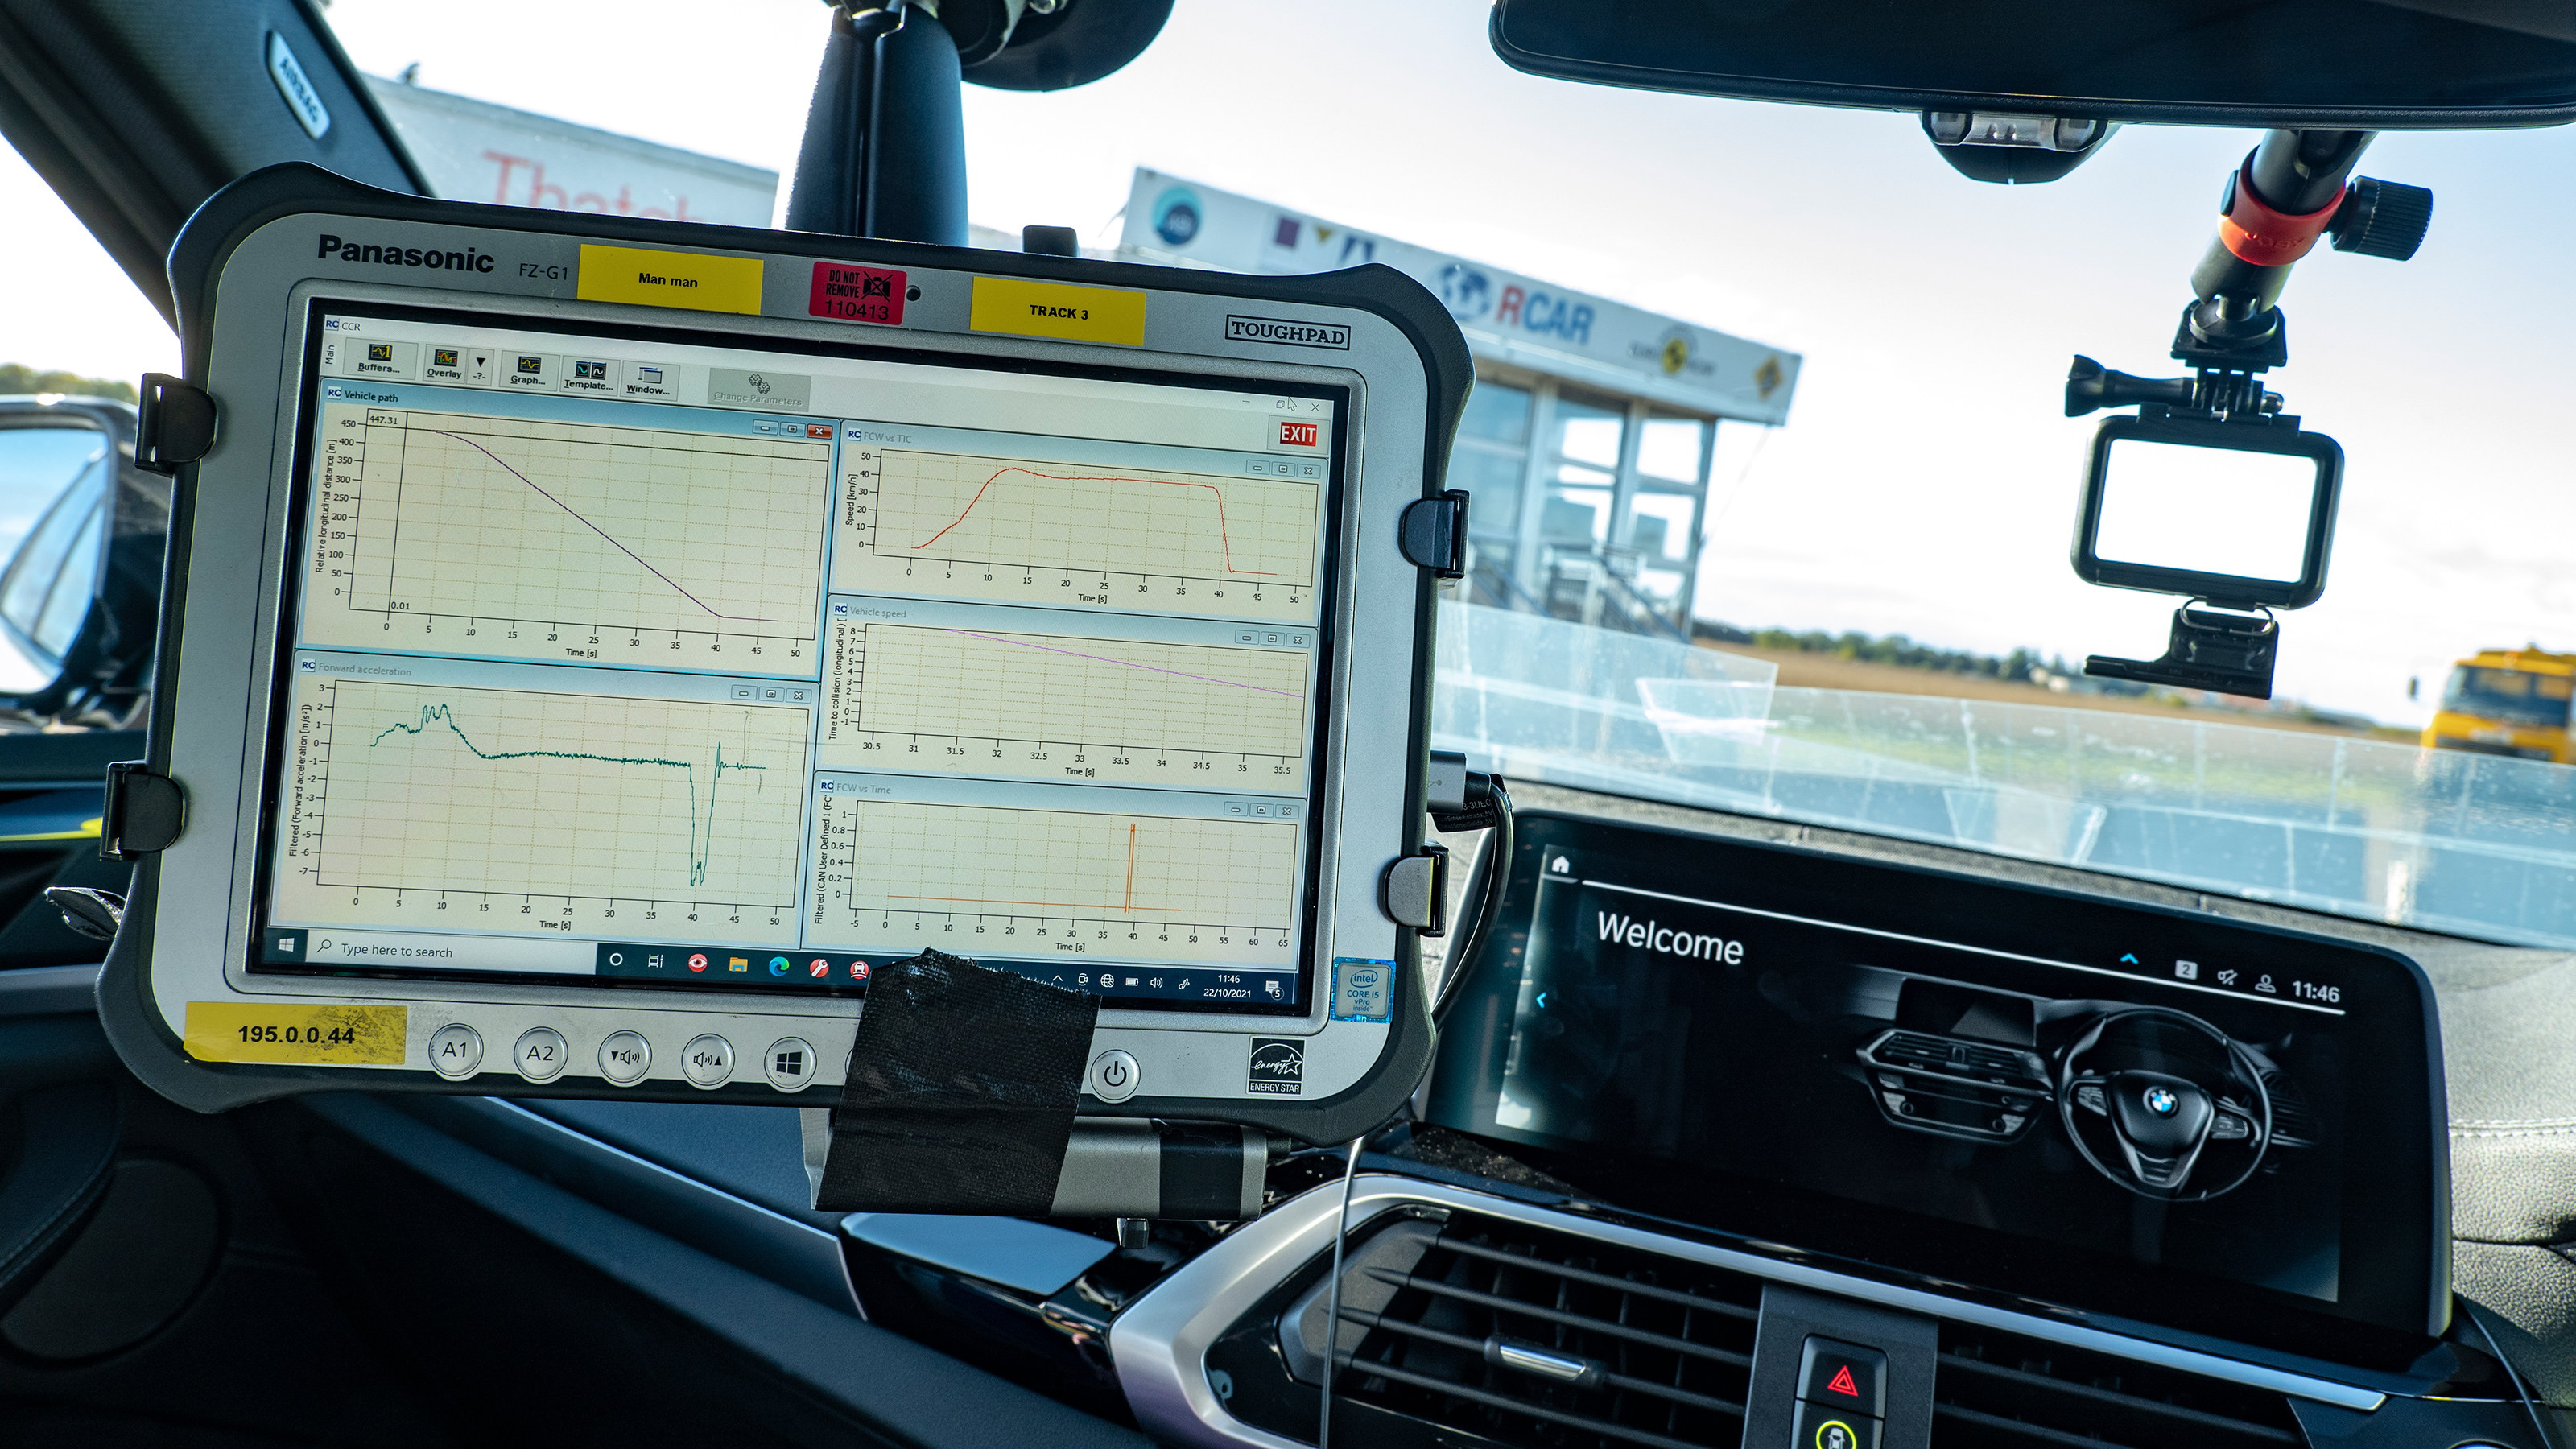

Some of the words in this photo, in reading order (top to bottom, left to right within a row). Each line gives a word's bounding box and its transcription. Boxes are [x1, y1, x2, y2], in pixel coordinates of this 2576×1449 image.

[280, 58, 318, 122] AIRBAG
[318, 234, 494, 273] Panasonic
[519, 263, 568, 280] FZ-G1
[639, 273, 666, 285] Man
[671, 278, 697, 287] man
[829, 270, 840, 282] DO
[844, 271, 860, 284] NOT
[826, 283, 860, 298] REMOVE
[826, 299, 889, 320] 110413
[1030, 304, 1076, 319] TRACK
[1081, 310, 1088, 320] 3
[1496, 283, 1596, 345] RCAR
[326, 320, 339, 328] RC
[341, 322, 361, 331] CCR
[1232, 321, 1344, 345] TOUGHPAD
[325, 345, 335, 364] Main
[358, 363, 400, 374] Buffers...
[427, 369, 461, 379] Overlay
[473, 372, 485, 380] -?-
[510, 375, 546, 385] Graph...
[564, 379, 613, 390] Template...
[626, 385, 670, 395] Window...
[714, 392, 748, 402] Change
[750, 395, 802, 406] Parameters
[328, 389, 341, 397] RC
[345, 390, 375, 401] Vehicle
[378, 394, 398, 403] path
[341, 420, 356, 428] 450
[369, 415, 398, 425] 447.31
[339, 438, 354, 446] 400
[848, 431, 861, 439] RC
[864, 432, 884, 440] FCW
[898, 435, 911, 443] TTC
[1282, 425, 1316, 443] EXIT
[326, 439, 337, 454] [m]
[337, 456, 353, 464] 350
[323, 456, 334, 488] distance
[335, 476, 350, 484] 300
[847, 474, 858, 500] [km/h]
[318, 491, 330, 537] longitudinal
[845, 502, 854, 525] Speed
[316, 539, 326, 572] Relative
[1079, 594, 1095, 602] Time
[1098, 594, 1107, 604] [s]
[835, 605, 847, 613] RC
[850, 607, 880, 617] Vehicle
[882, 609, 906, 618] speed
[508, 631, 518, 639] 15
[589, 636, 599, 644] 25
[671, 642, 680, 650] 35
[711, 644, 720, 652] 40
[751, 646, 761, 654] 45
[833, 625, 845, 675] (longitudinal)
[566, 648, 584, 657] Time
[587, 649, 597, 659] [s]
[302, 661, 316, 669] RC
[319, 663, 355, 673] Forward
[357, 667, 411, 676] acceleration
[832, 678, 840, 709] collision
[832, 711, 838, 719] to
[829, 721, 837, 740] Time
[296, 735, 308, 785] acceleration
[863, 742, 881, 750] 30.5
[909, 745, 919, 753] 31
[947, 747, 964, 755] 31.5
[1030, 752, 1047, 761] 32.5
[1112, 757, 1129, 765] 33.5
[1193, 762, 1210, 770] 34.5
[1274, 766, 1290, 774] 35.5
[1066, 768, 1083, 776] Time
[1085, 768, 1095, 778] [s]
[837, 783, 857, 791] FCW
[870, 786, 891, 794] Time
[292, 786, 303, 823] (Forward
[289, 824, 299, 857] Filtered
[820, 819, 830, 850] Defined
[819, 852, 828, 869] User
[817, 871, 826, 892] (CAN
[815, 894, 824, 924] Filtered
[539, 920, 558, 929] Time
[561, 921, 571, 931] [s]
[1598, 910, 1744, 965] Welcome
[342, 944, 368, 956] Type
[372, 946, 397, 956] here
[401, 947, 412, 956] to
[415, 948, 452, 958] search
[1056, 943, 1073, 952] Time
[1075, 943, 1085, 952] [s]
[1218, 975, 1240, 983] 11:46
[1354, 973, 1373, 982] intel
[1203, 989, 1251, 998] 22/10/2021
[2293, 980, 2340, 1003] 11:46
[238, 1026, 355, 1045] 195.0.0.44
[442, 1042, 467, 1058] A1
[526, 1046, 554, 1061] A2
[1251, 1060, 1287, 1074] energy
[1250, 1083, 1279, 1092] ENERGY
[1281, 1084, 1299, 1092] STAR
